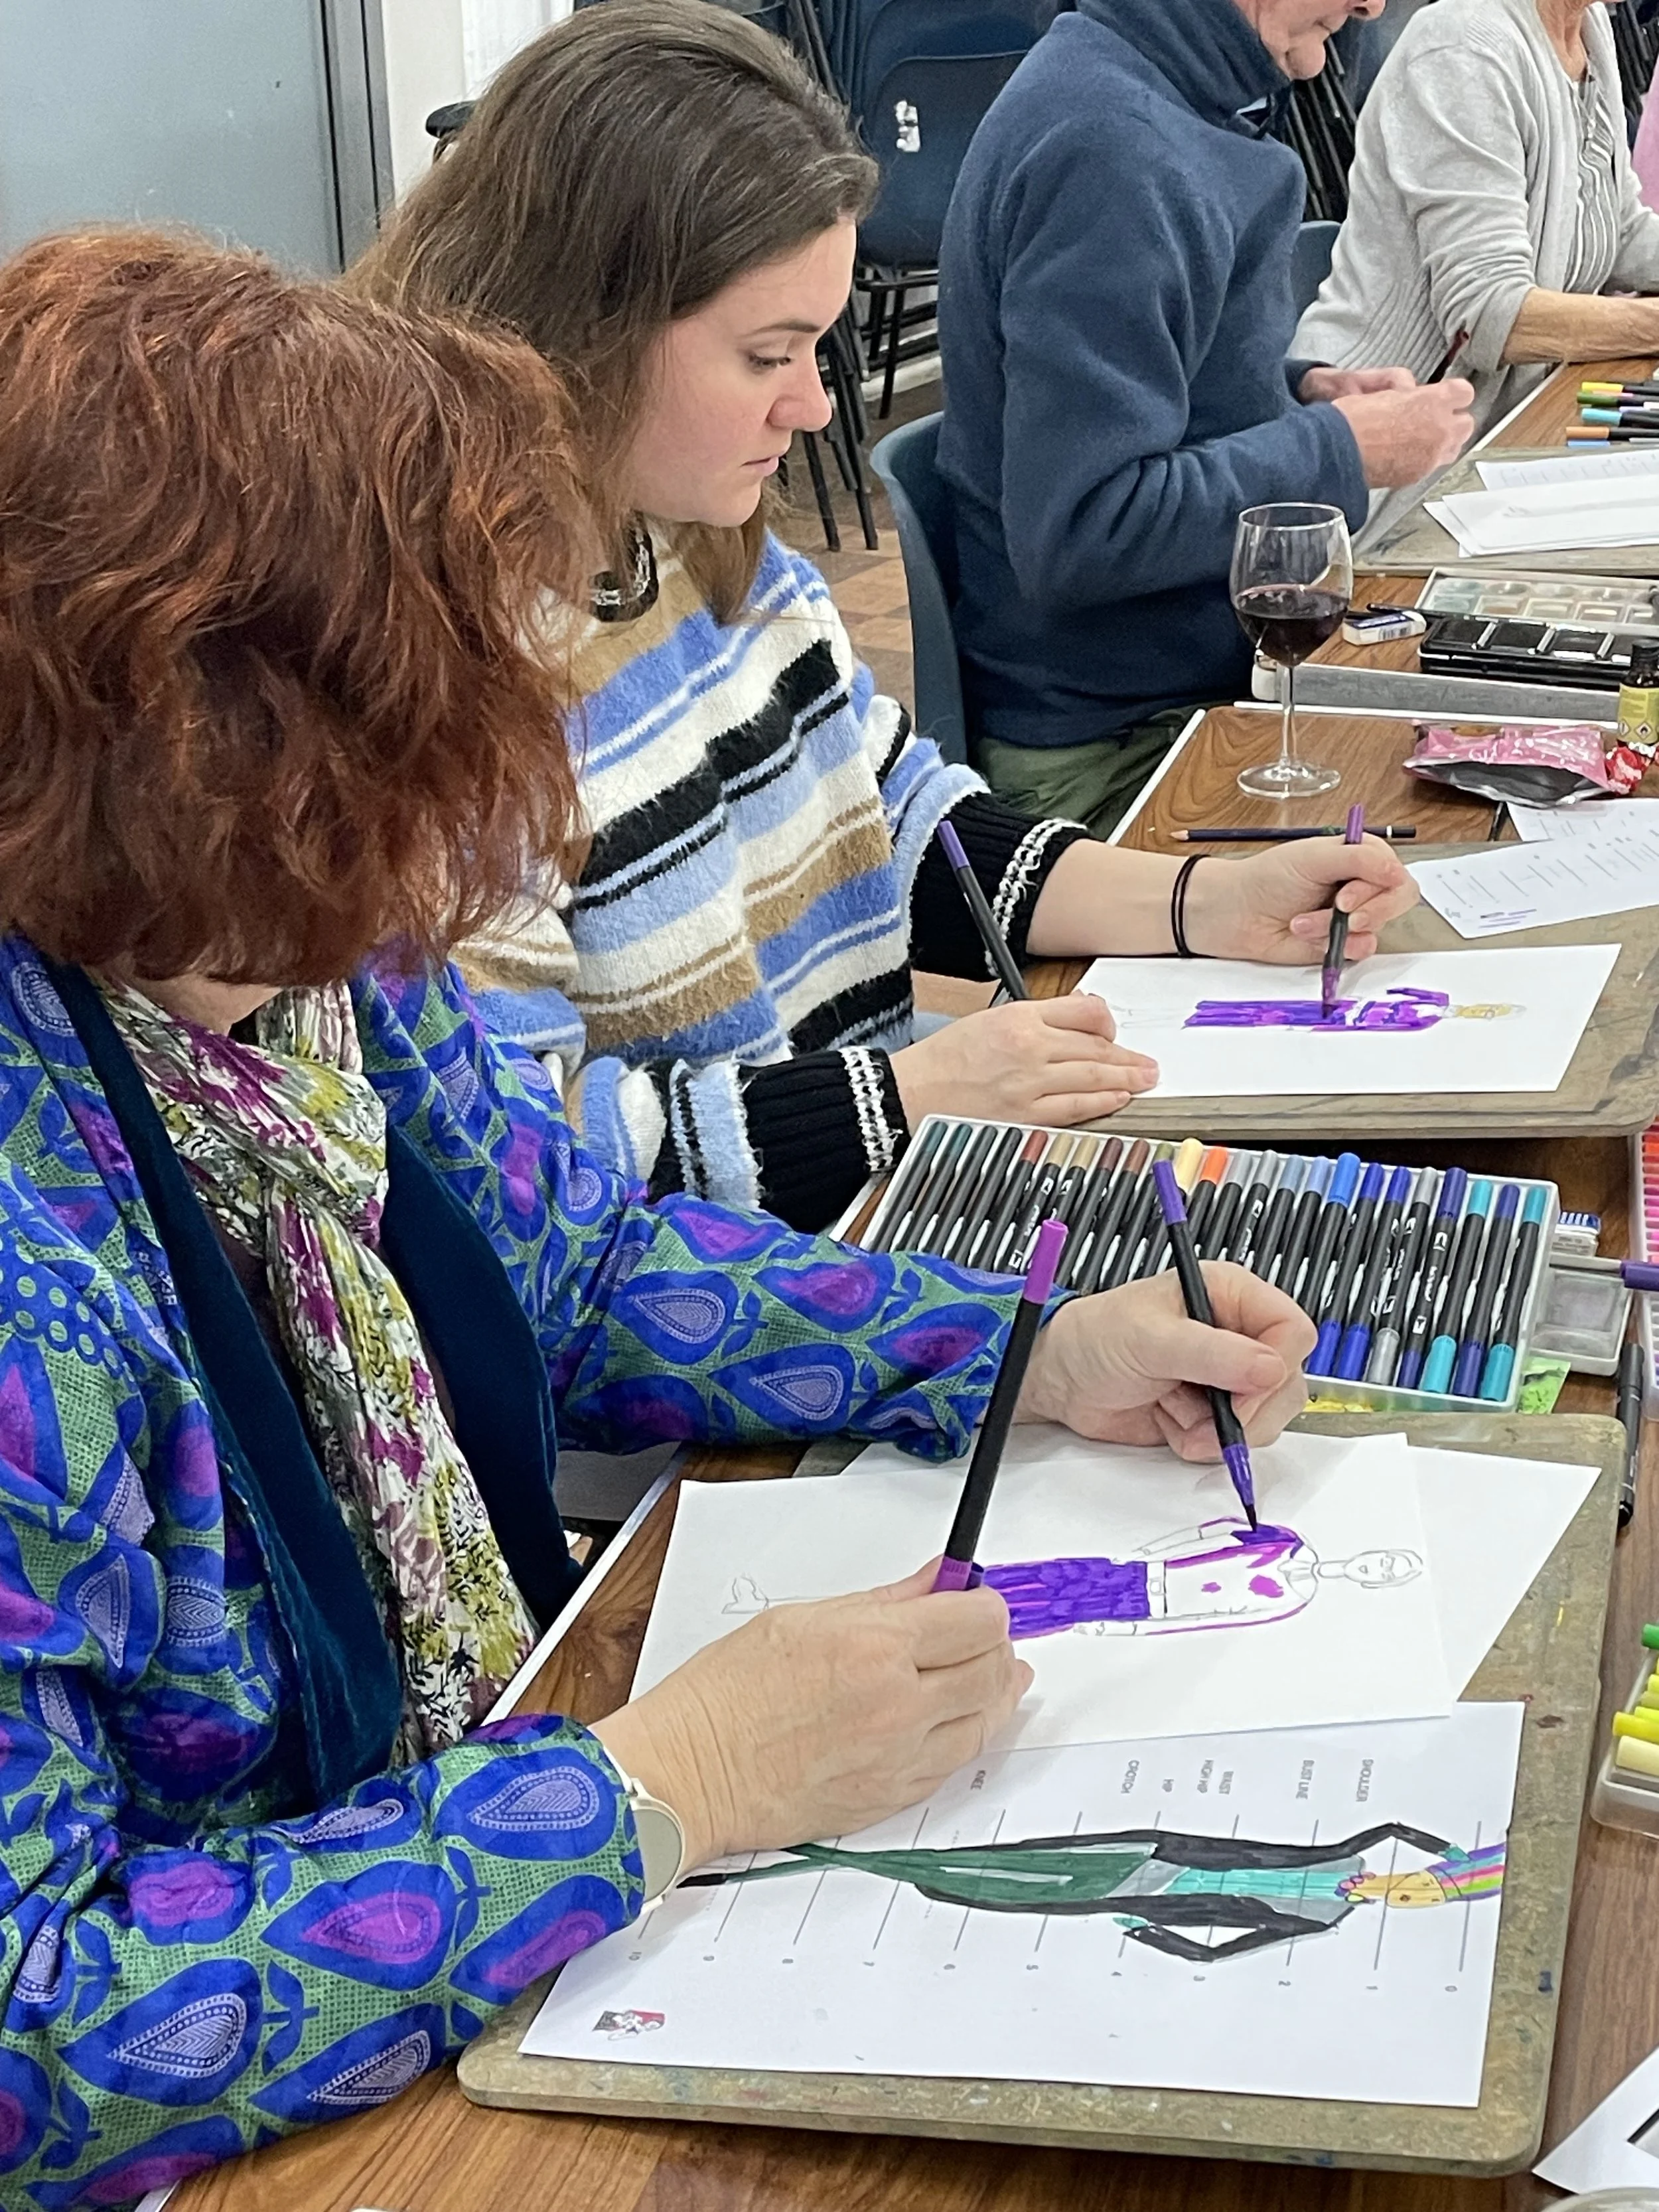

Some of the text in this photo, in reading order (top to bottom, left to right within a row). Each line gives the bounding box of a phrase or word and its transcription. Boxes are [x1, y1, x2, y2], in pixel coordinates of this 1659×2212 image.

[970, 1769, 986, 1790] KNEE
[1120, 1759, 1140, 1794] CROTCH
[1200, 1759, 1214, 1779] HIGH
[1295, 1759, 1315, 1800] BUST LINE
[1356, 1759, 1374, 1803] SHOULDER
